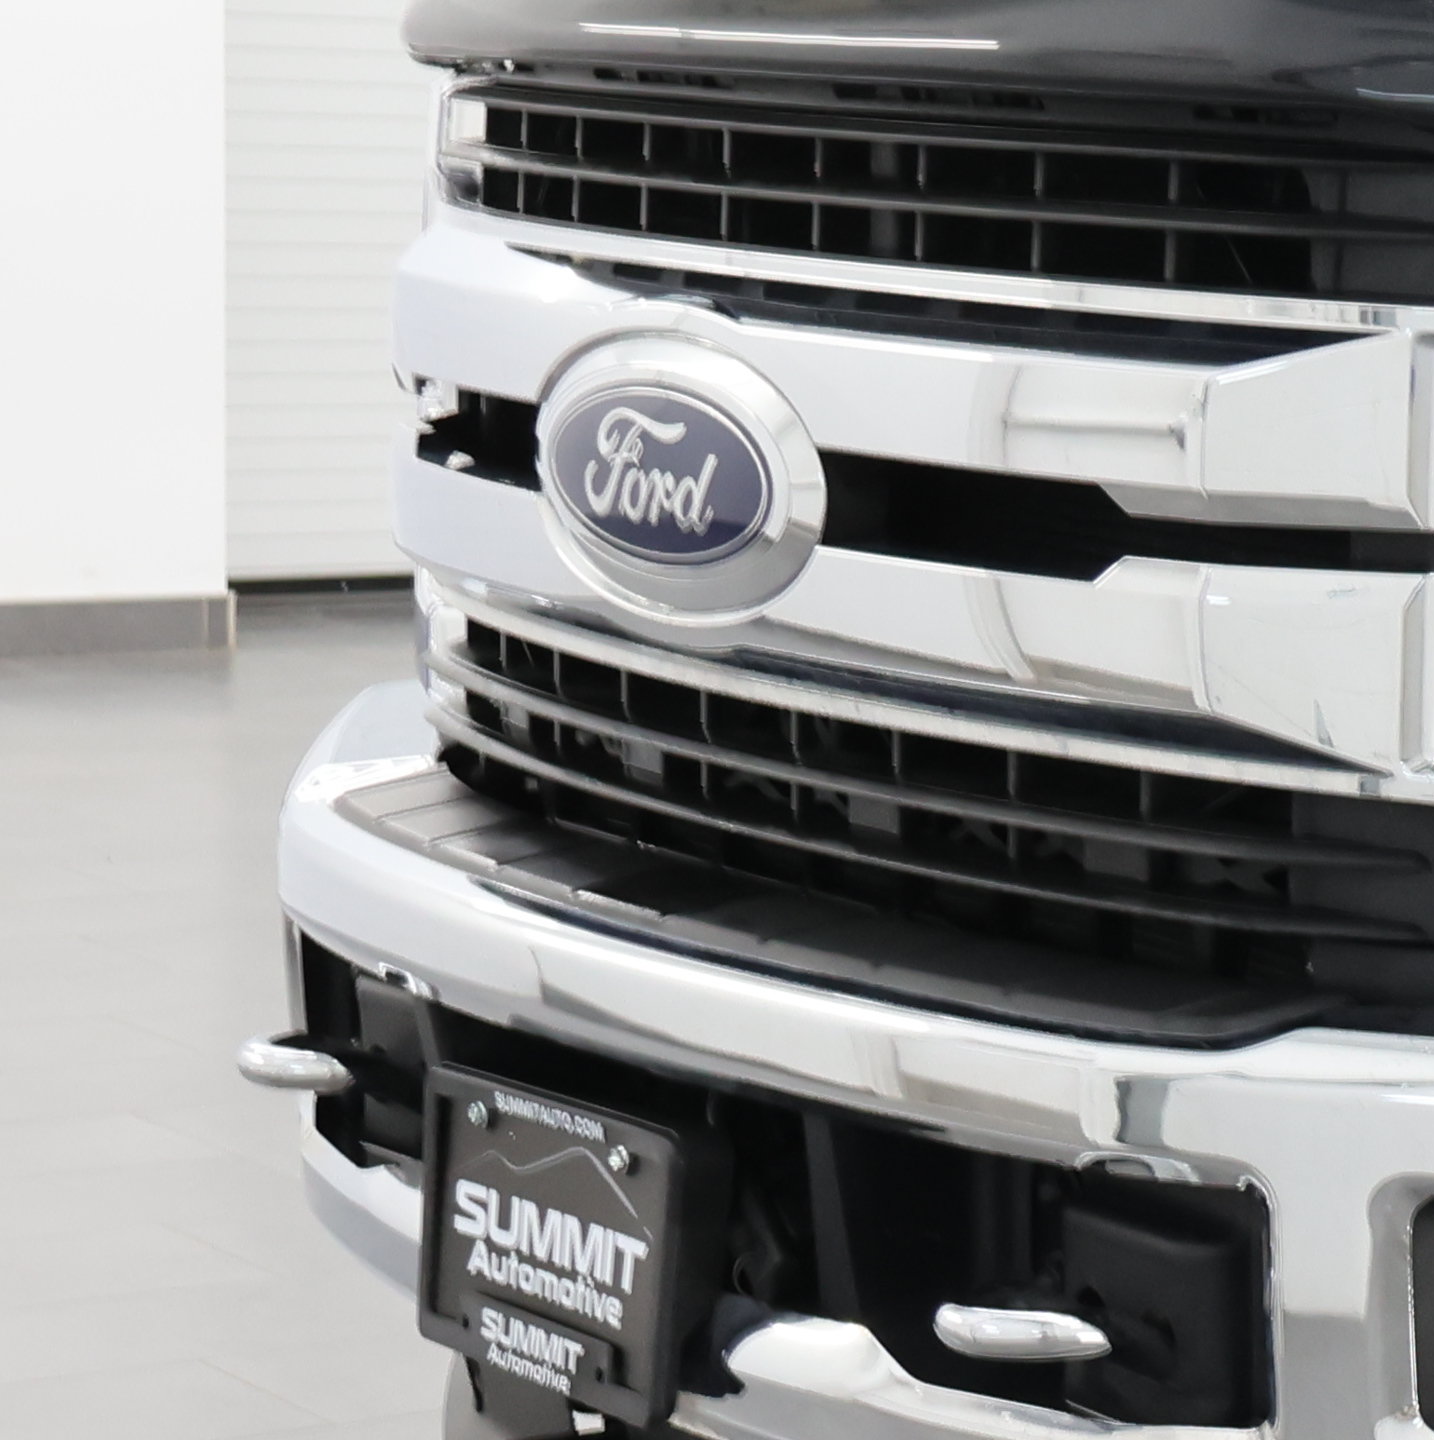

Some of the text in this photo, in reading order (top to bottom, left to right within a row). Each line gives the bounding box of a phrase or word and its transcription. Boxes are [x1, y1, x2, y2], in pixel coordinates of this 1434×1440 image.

[584, 407, 718, 537] Ford
[494, 1091, 606, 1144] SUMMITAUTO.COM
[453, 1178, 649, 1295] SUMMIT
[466, 1240, 623, 1330] Automotive
[480, 1306, 585, 1375] SUMMIT
[487, 1343, 572, 1396] Automotive
